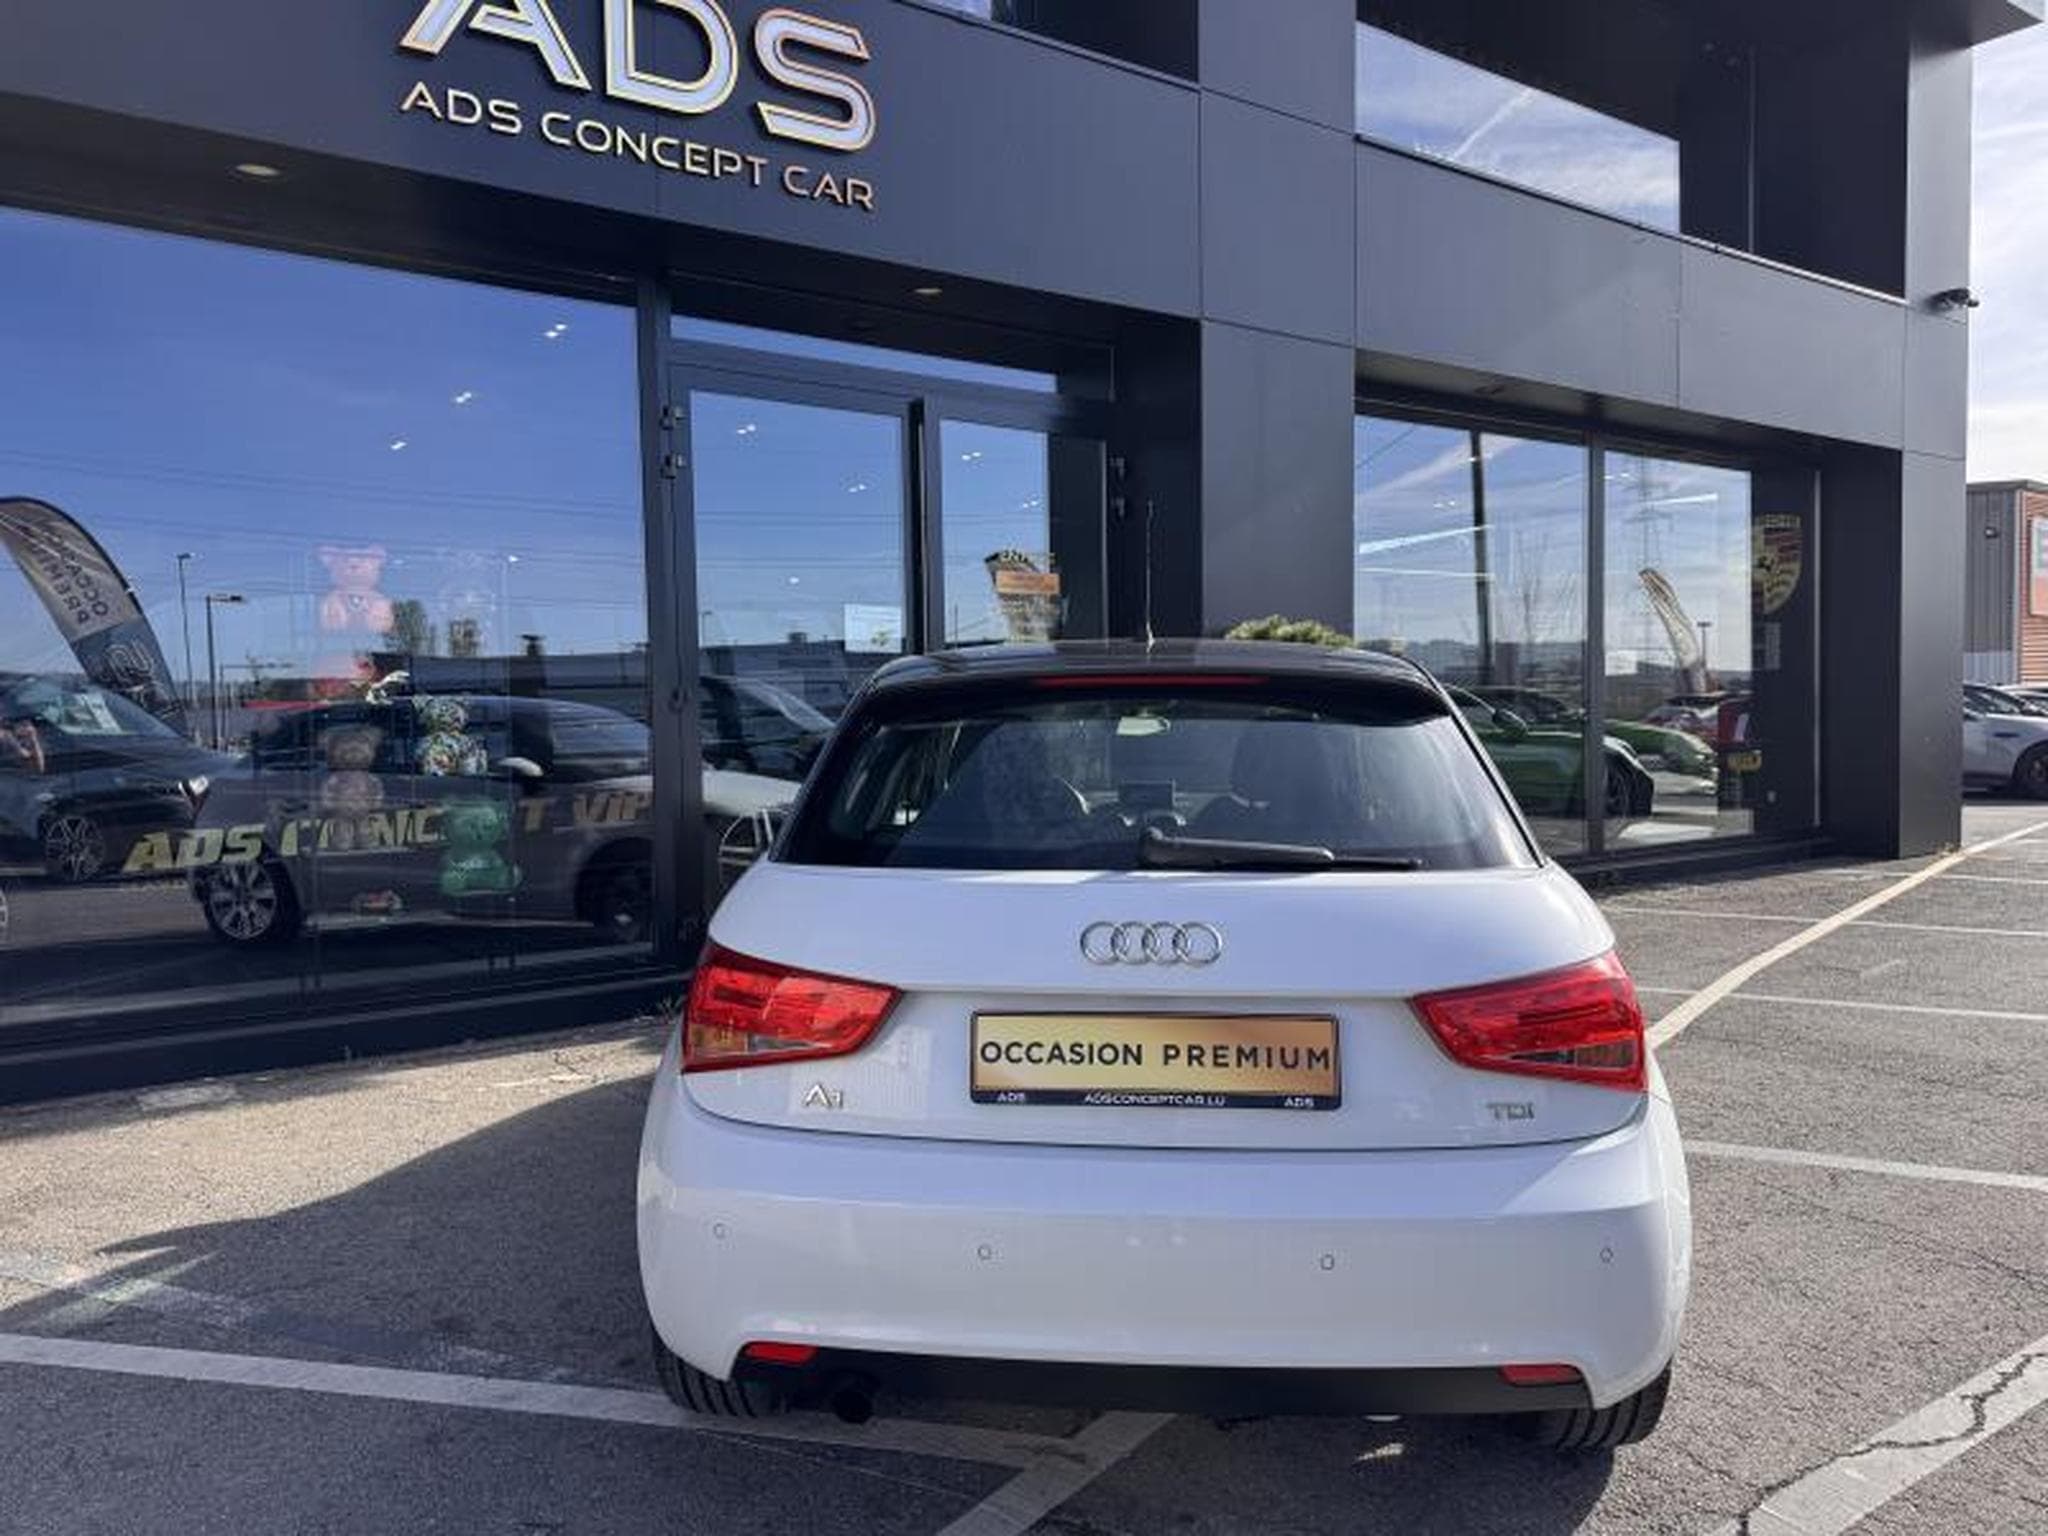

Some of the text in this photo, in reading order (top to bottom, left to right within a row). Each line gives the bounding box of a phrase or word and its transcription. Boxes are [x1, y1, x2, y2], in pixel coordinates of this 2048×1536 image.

[399, 0, 876, 152] ADS
[401, 81, 874, 210] ADS CONCEPT CAR
[122, 823, 267, 873] ADS
[979, 1041, 1330, 1070] OCCASION PREMIUM
